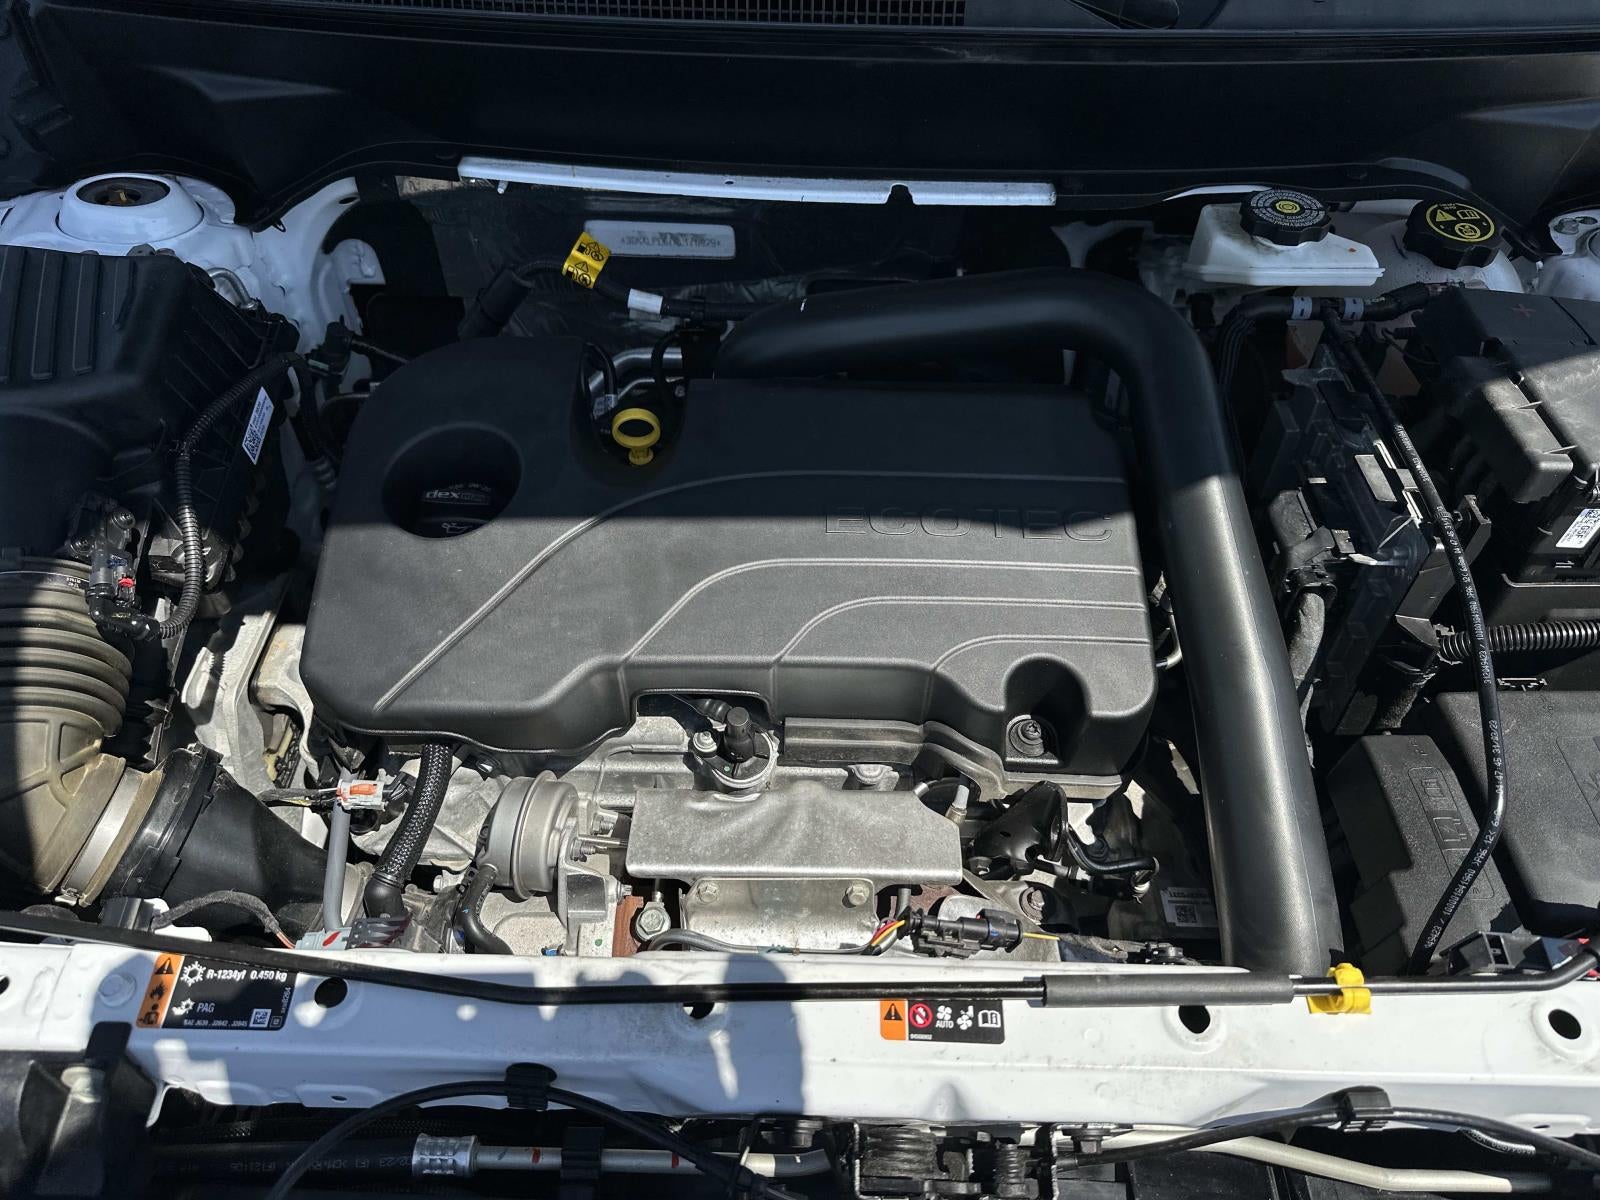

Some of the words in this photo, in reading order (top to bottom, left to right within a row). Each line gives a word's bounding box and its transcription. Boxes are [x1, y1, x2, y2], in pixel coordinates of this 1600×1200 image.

[824, 506, 1113, 542] ECOTEC
[206, 969, 247, 982] R-1234yf
[250, 970, 274, 981] 0.450
[275, 972, 288, 983] kg
[197, 1003, 215, 1013] PAG
[935, 1020, 954, 1029] AUTO
